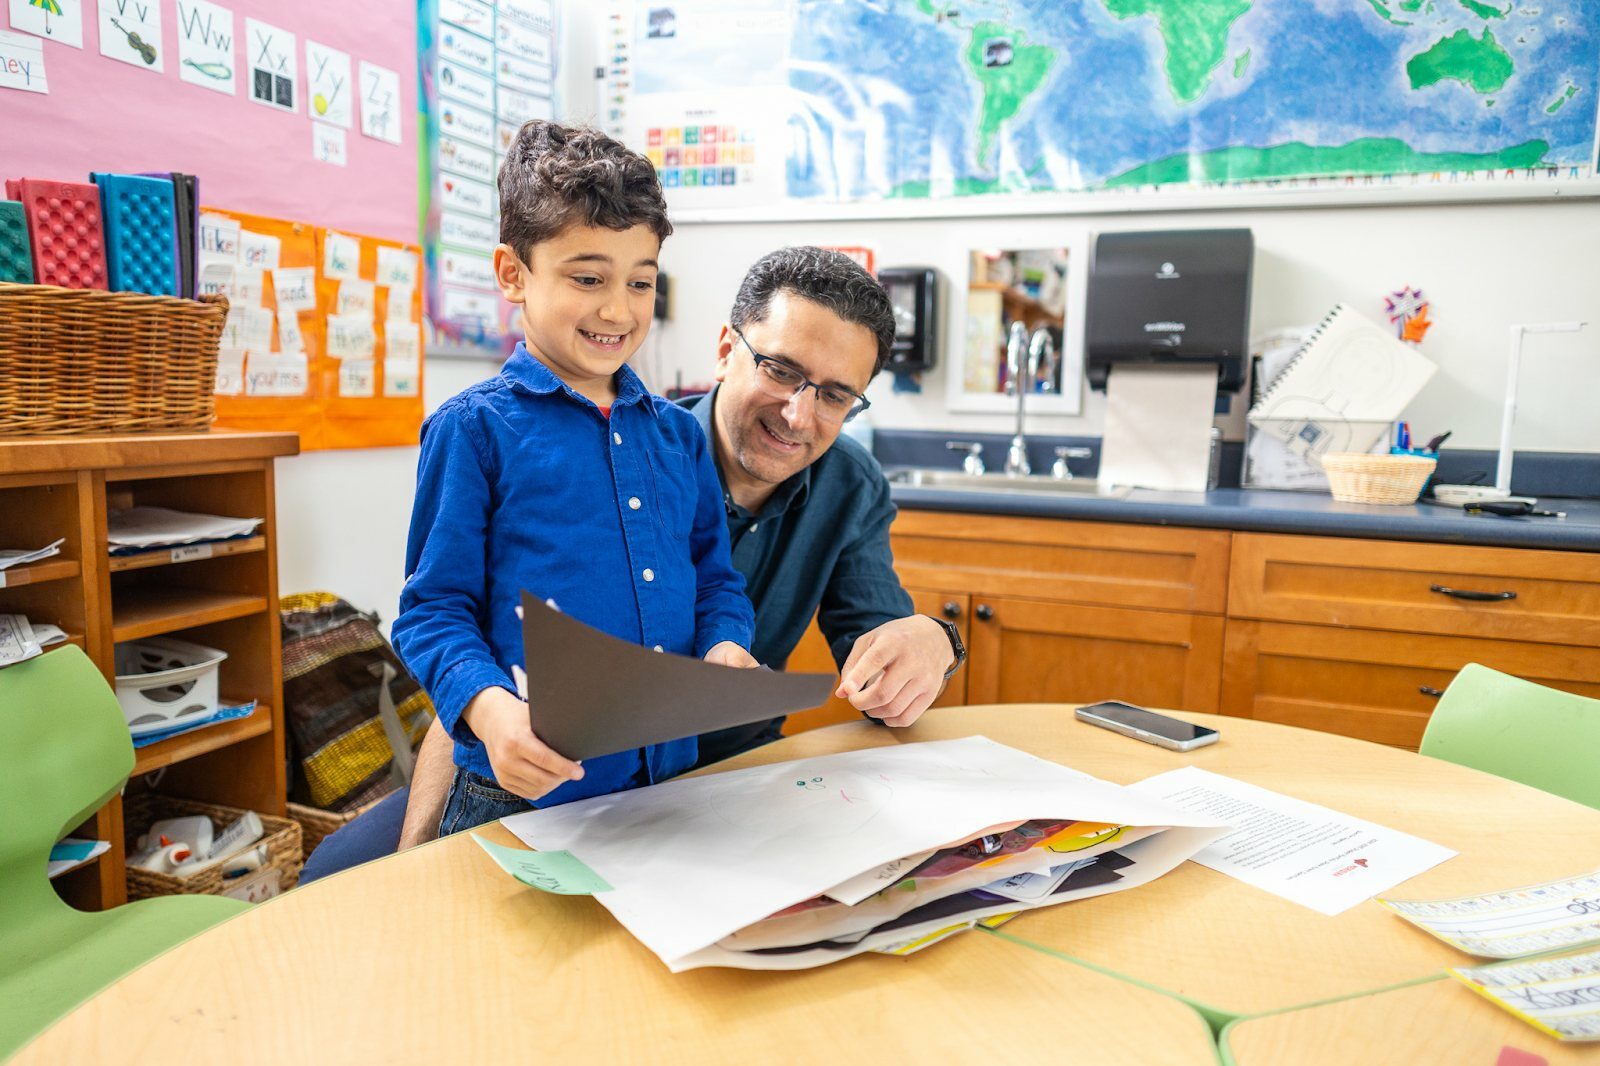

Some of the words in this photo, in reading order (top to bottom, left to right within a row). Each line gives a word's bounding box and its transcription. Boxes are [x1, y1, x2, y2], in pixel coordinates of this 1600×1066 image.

[178, 1, 231, 53] Ww
[256, 29, 290, 73] Xx
[313, 51, 345, 105] Yy
[367, 71, 393, 107] Zz
[201, 226, 235, 254] like
[245, 245, 268, 268] get
[279, 276, 308, 302] and
